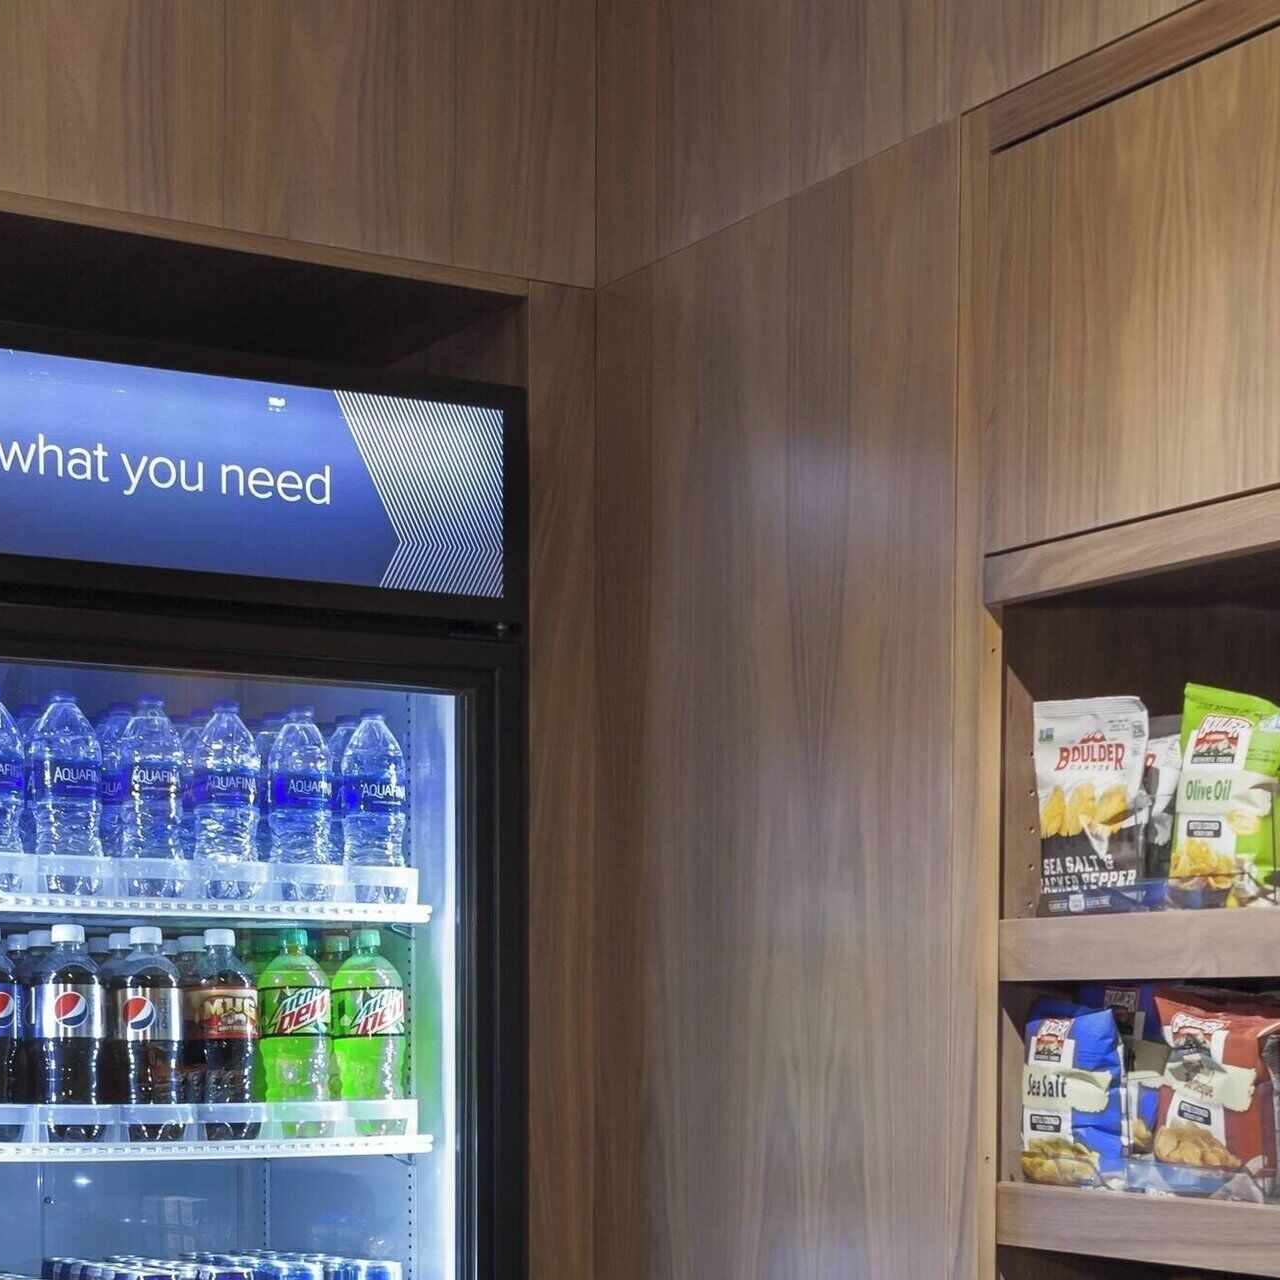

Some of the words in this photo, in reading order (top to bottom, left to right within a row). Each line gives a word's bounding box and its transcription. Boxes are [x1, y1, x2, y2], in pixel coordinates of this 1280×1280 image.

[120, 451, 204, 496] you
[221, 465, 331, 506] need
[1055, 742, 1126, 771] BOULDER
[206, 775, 257, 793] AQUAFINA
[1186, 780, 1212, 800] Olive
[1214, 780, 1231, 800] Oil
[1044, 859, 1062, 875] SEA
[1067, 855, 1098, 873] SALT
[1105, 856, 1114, 870] &
[1083, 869, 1137, 890] PEPPER
[1028, 1073, 1041, 1096] Sea
[1042, 1075, 1067, 1098] Salt
